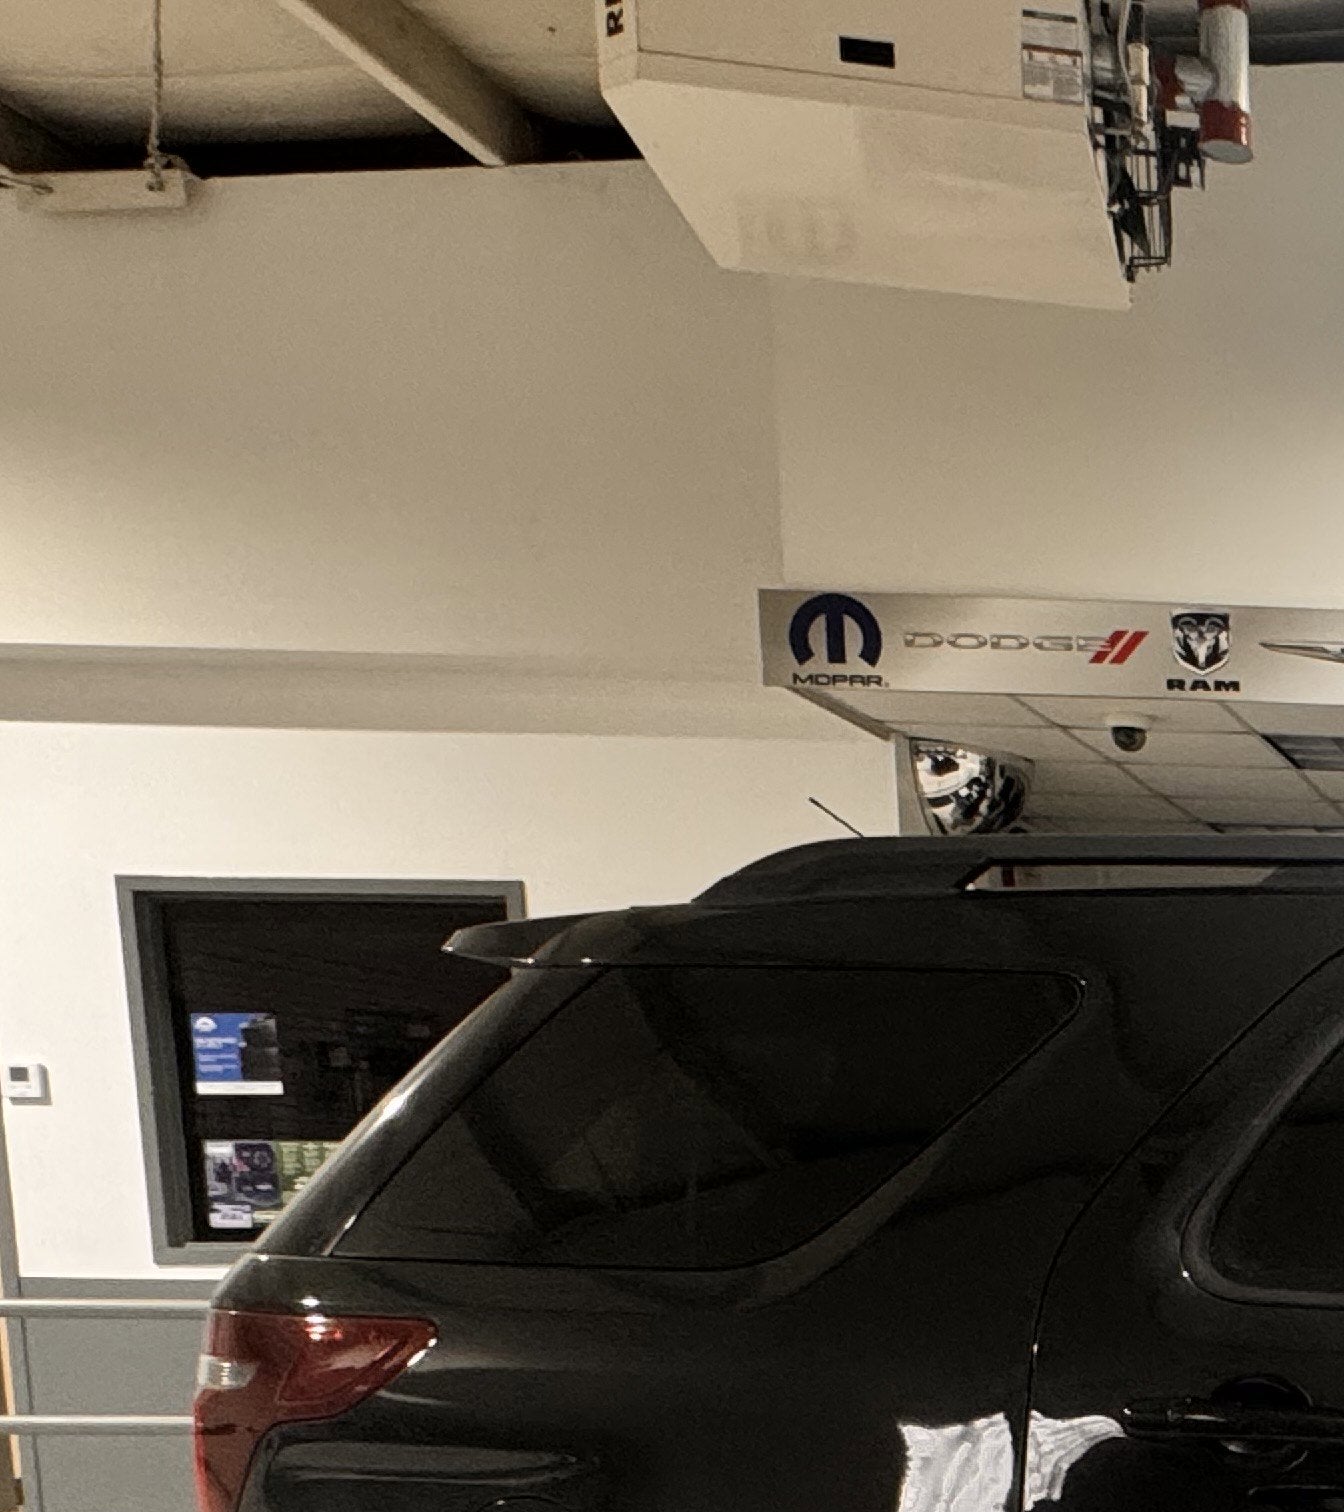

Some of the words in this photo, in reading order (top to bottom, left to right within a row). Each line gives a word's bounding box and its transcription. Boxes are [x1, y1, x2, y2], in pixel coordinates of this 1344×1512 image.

[903, 632, 1112, 651] DODGE
[792, 672, 883, 688] MOPAR
[1166, 678, 1241, 692] RAM
